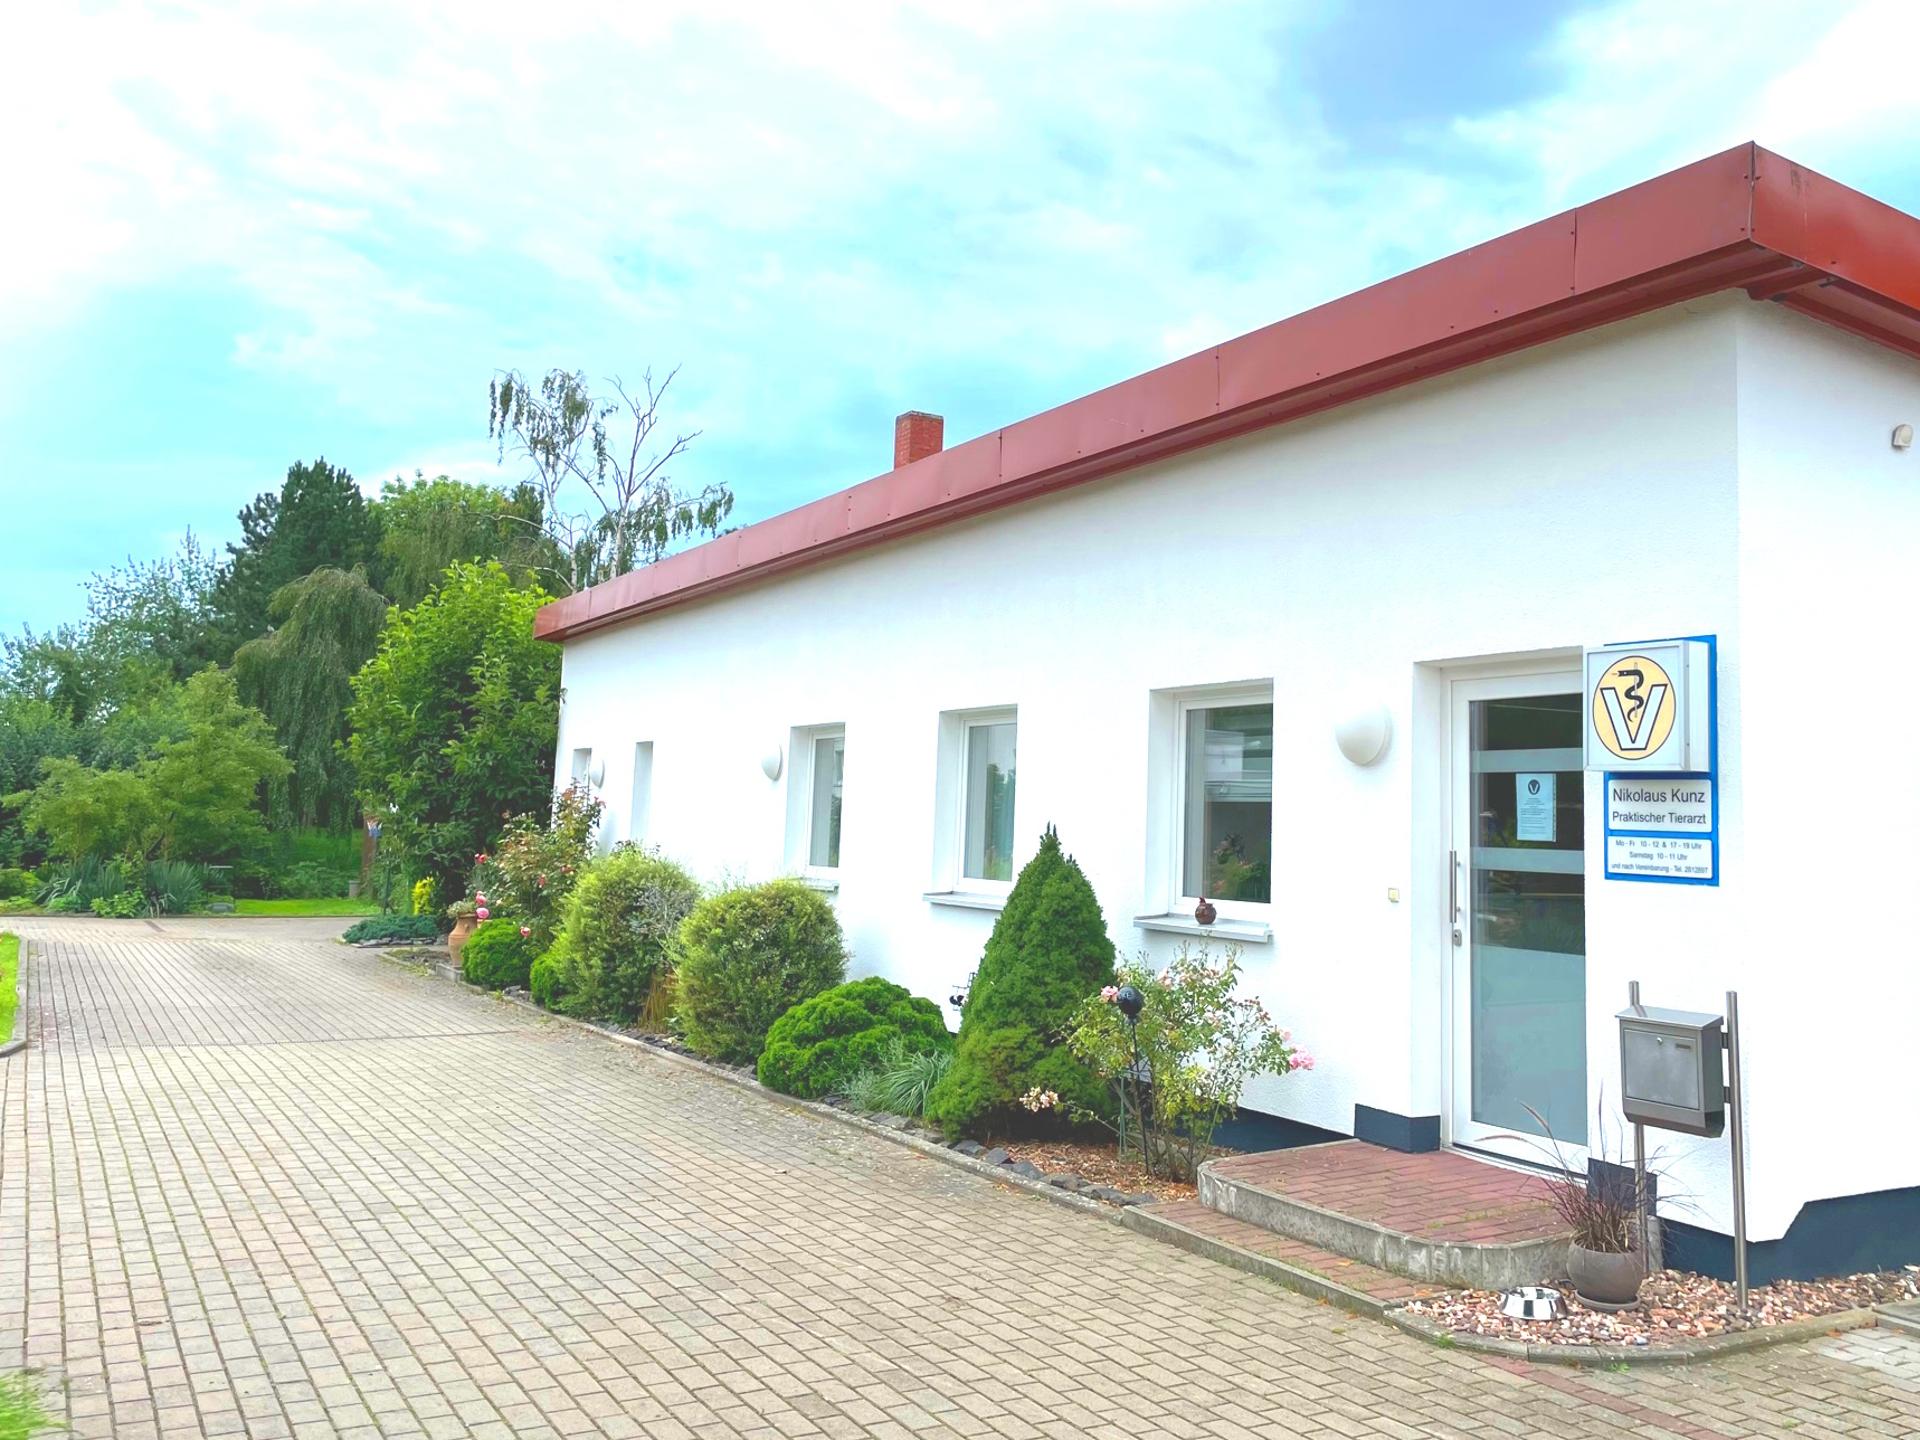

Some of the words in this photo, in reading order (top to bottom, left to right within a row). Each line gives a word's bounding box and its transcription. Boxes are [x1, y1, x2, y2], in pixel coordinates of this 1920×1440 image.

[1613, 788, 1667, 803] Nikolaus
[1671, 788, 1706, 804] Kunz
[1612, 811, 1666, 823] Praktischer
[1668, 812, 1707, 824] Tierarzt
[1629, 851, 1654, 860] Samstag
[1635, 864, 1670, 873] Vereinbarung
